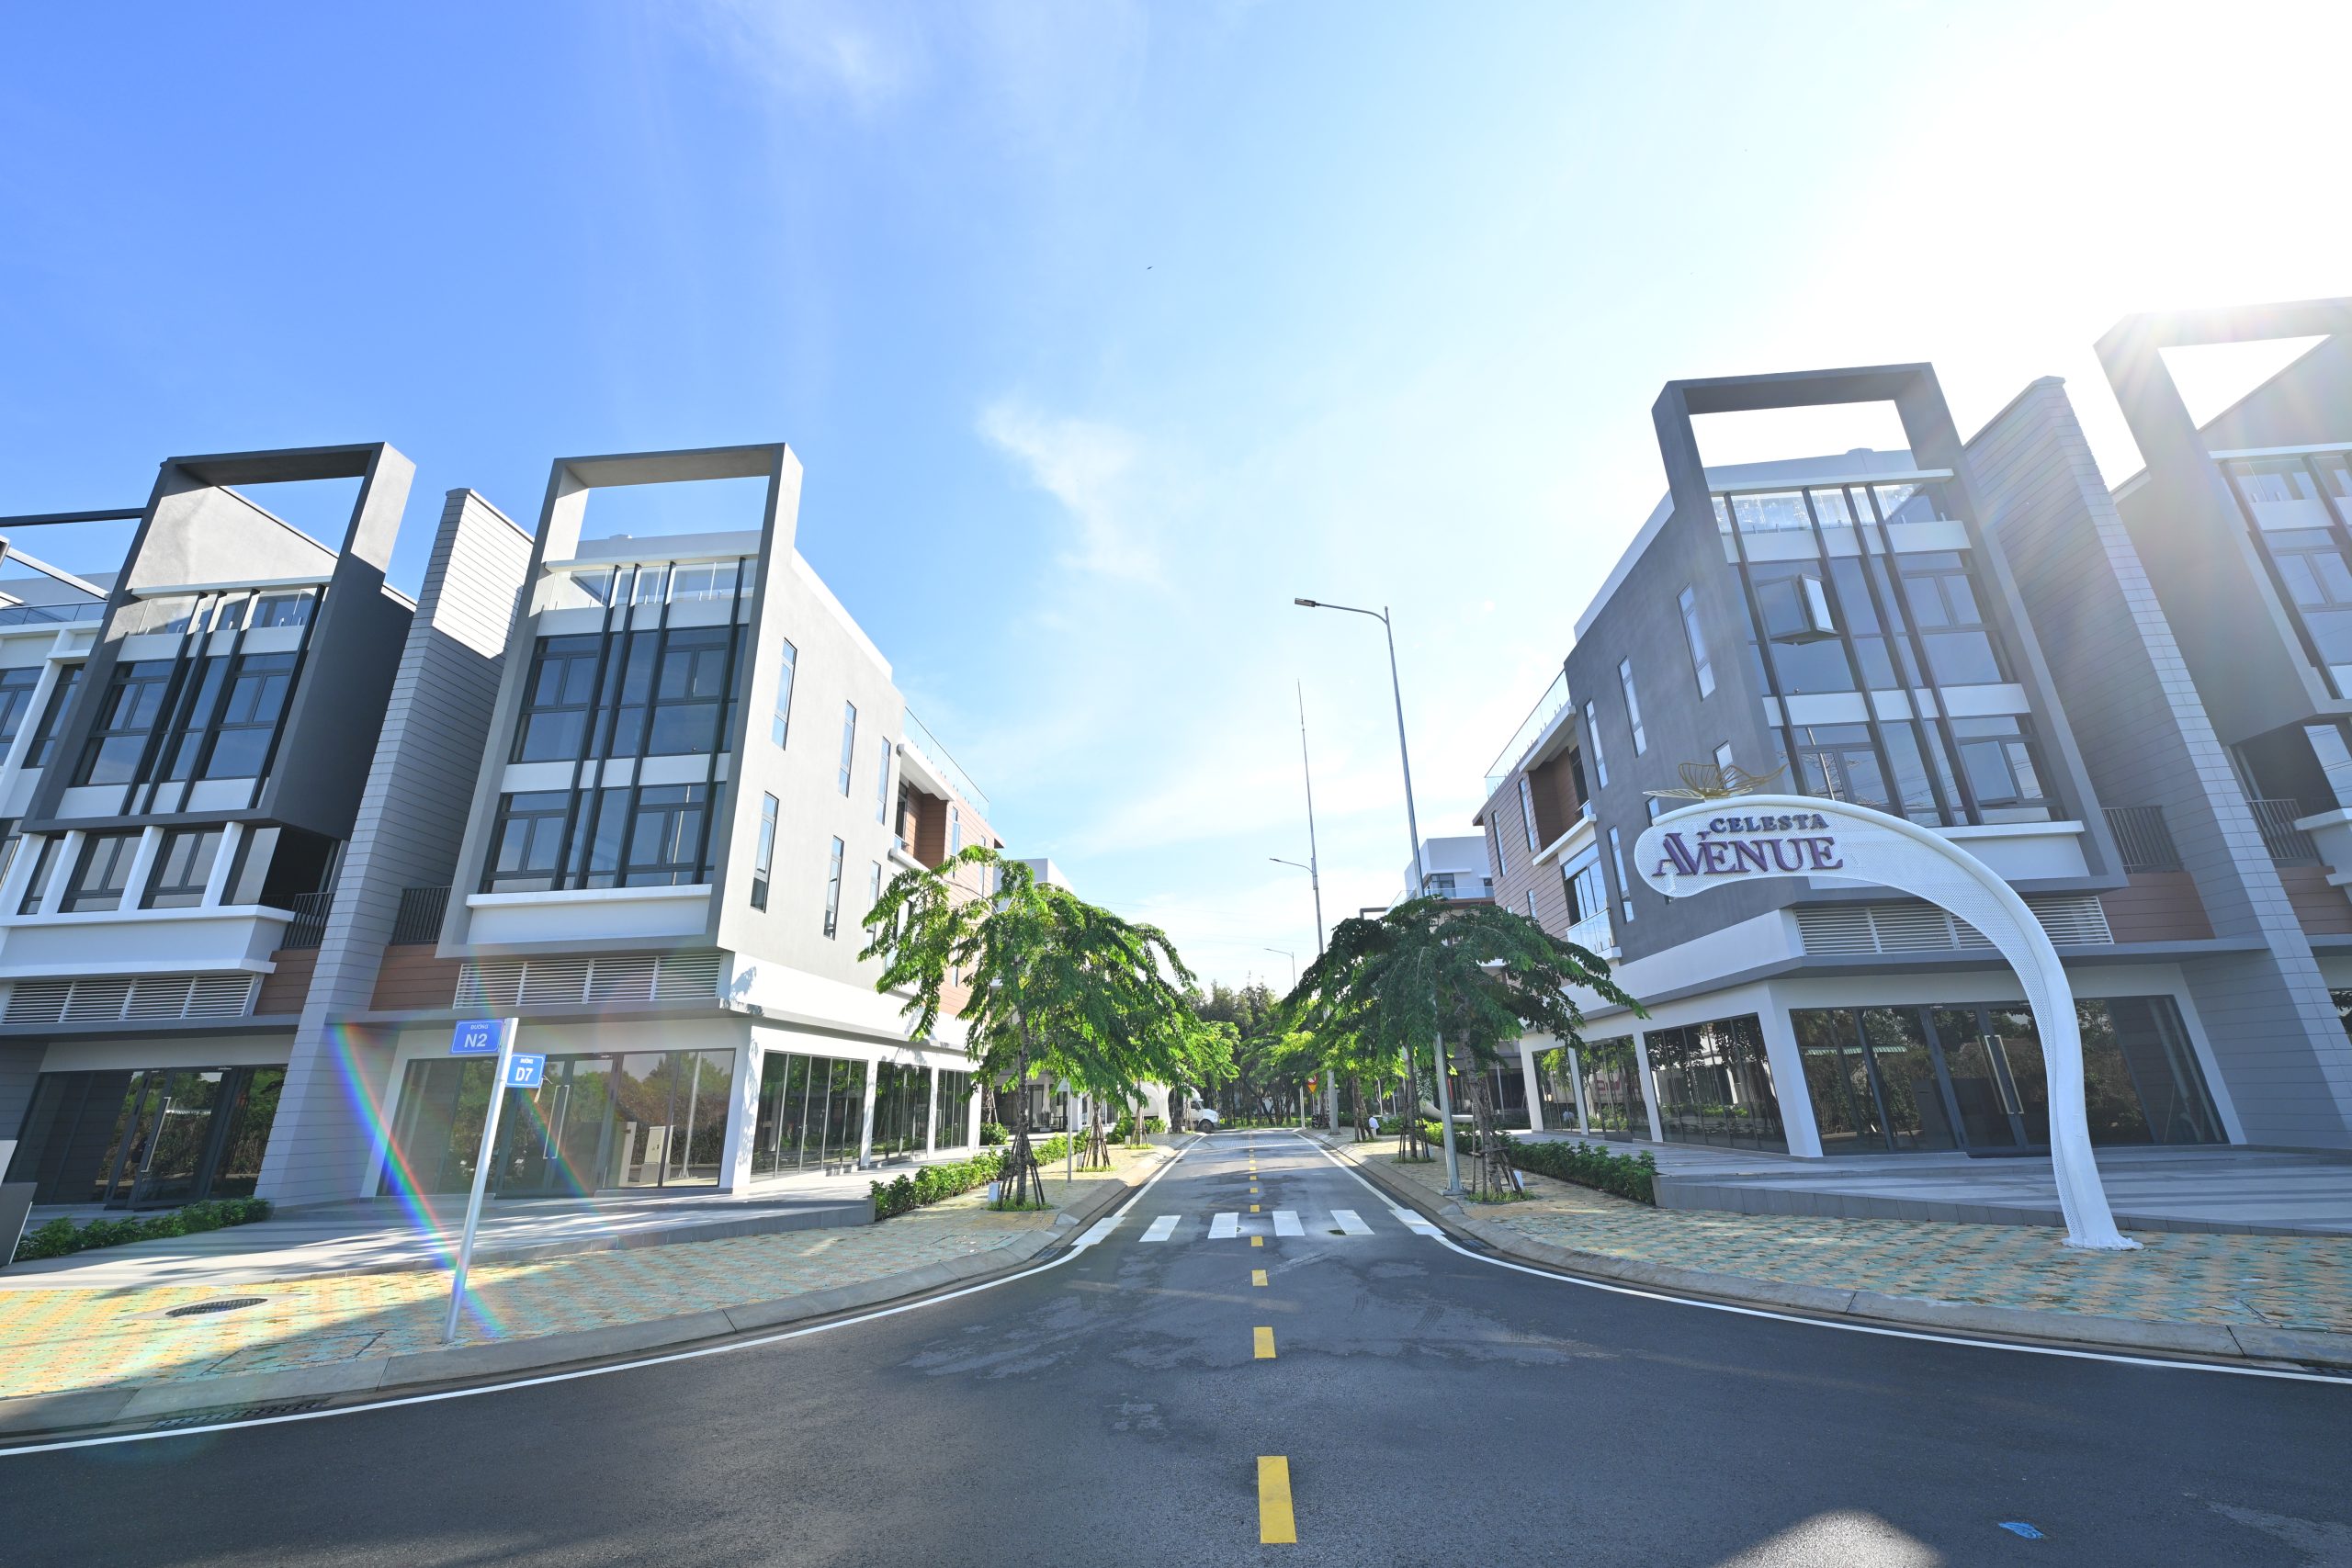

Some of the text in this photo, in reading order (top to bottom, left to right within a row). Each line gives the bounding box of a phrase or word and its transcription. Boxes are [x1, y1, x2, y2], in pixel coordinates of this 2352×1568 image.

[1710, 814, 1829, 833] CELESTA
[1652, 830, 1843, 876] AVENUE
[464, 1033, 488, 1048] N2
[514, 1066, 534, 1082] D7
